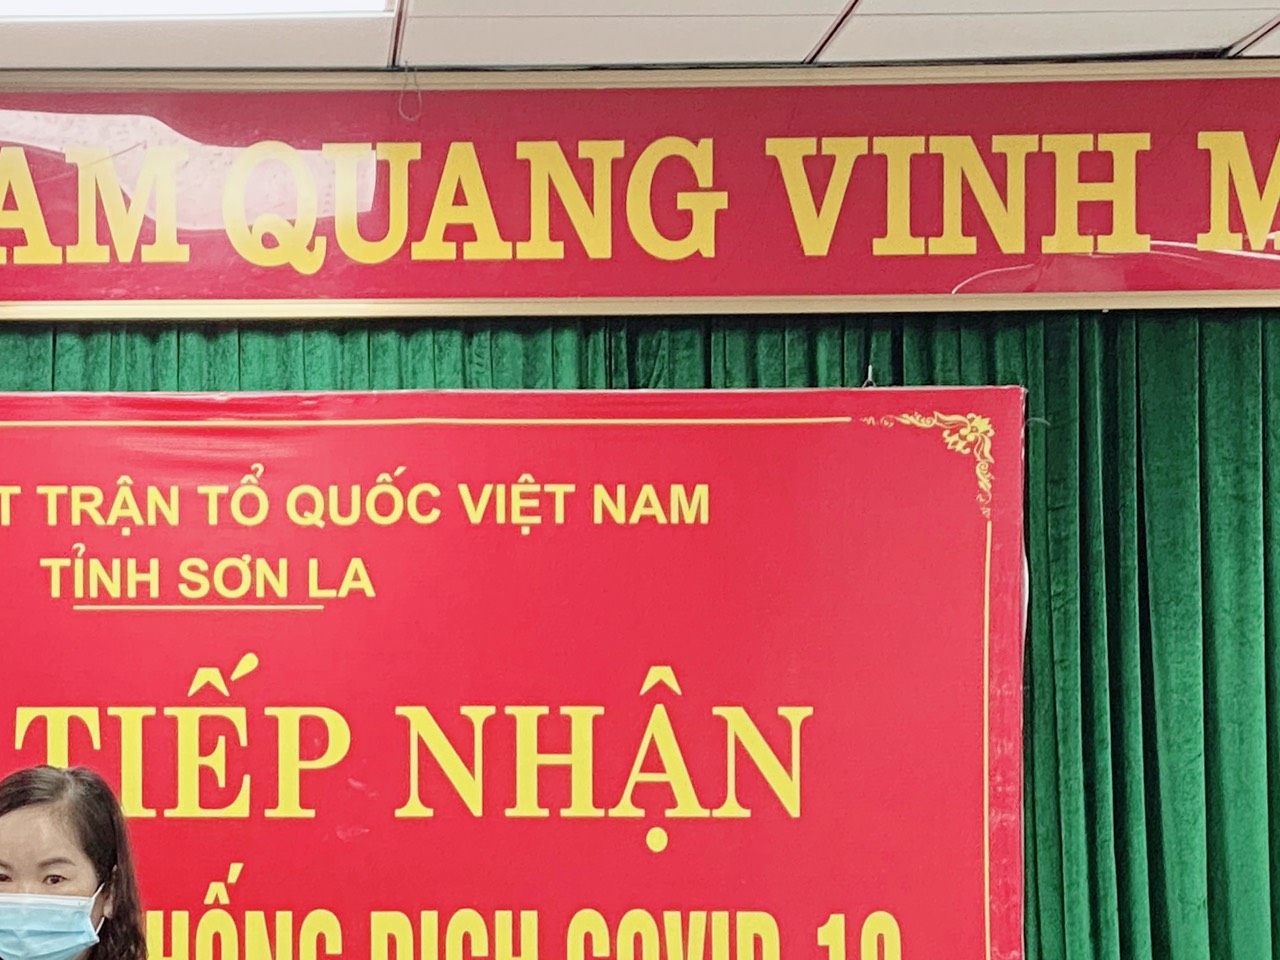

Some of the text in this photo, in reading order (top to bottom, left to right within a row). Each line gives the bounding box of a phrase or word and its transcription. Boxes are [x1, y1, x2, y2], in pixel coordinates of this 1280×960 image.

[222, 134, 728, 275] QUANG
[765, 132, 1151, 258] VINH
[1197, 131, 1280, 251] M
[36, 475, 180, 537] TRẬN
[197, 463, 270, 527] TỔ
[286, 466, 441, 528] QUỐC
[458, 473, 576, 536] VIỆT
[593, 484, 709, 525] NAM
[40, 543, 376, 599] TỈNH SƠN LA
[15, 652, 351, 818] TIẾP
[395, 665, 814, 853] NHẬN
